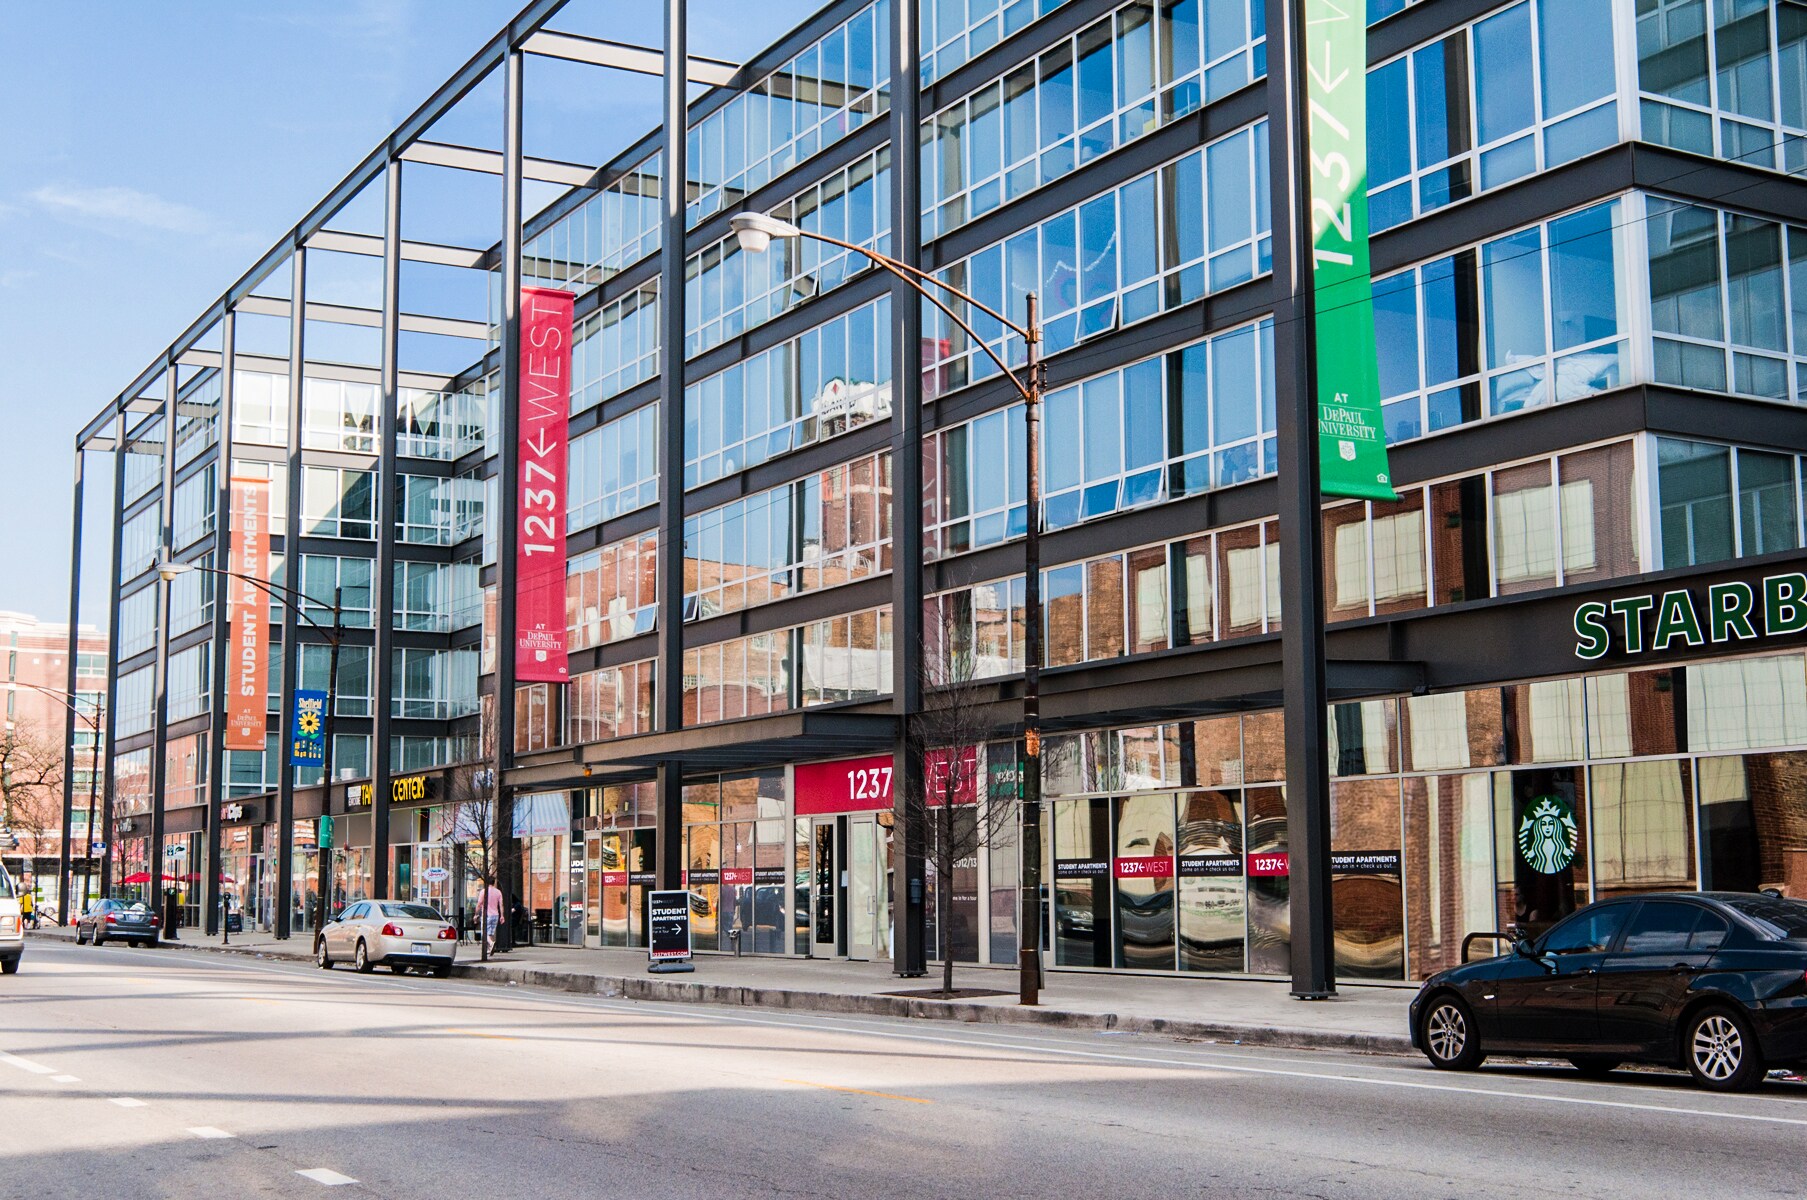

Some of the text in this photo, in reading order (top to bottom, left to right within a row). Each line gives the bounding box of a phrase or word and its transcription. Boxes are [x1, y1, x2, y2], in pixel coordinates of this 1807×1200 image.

[1308, 97, 1353, 271] 1237
[1333, 392, 1349, 404] AT
[525, 297, 564, 557] 1237 WEST
[241, 484, 257, 697] STUDENT APARTMENTS
[1573, 572, 1807, 660] STARB
[519, 638, 563, 649] UNIVERSITY
[230, 719, 263, 728] UNIVERSITY
[392, 775, 426, 802] CENTERS
[847, 767, 893, 800] 1237
[1255, 859, 1276, 871] 1237
[1331, 855, 1397, 864] TUDENT APARTMENTS
[1120, 861, 1169, 873] 1237 WEST
[652, 907, 687, 916] STUDENT
